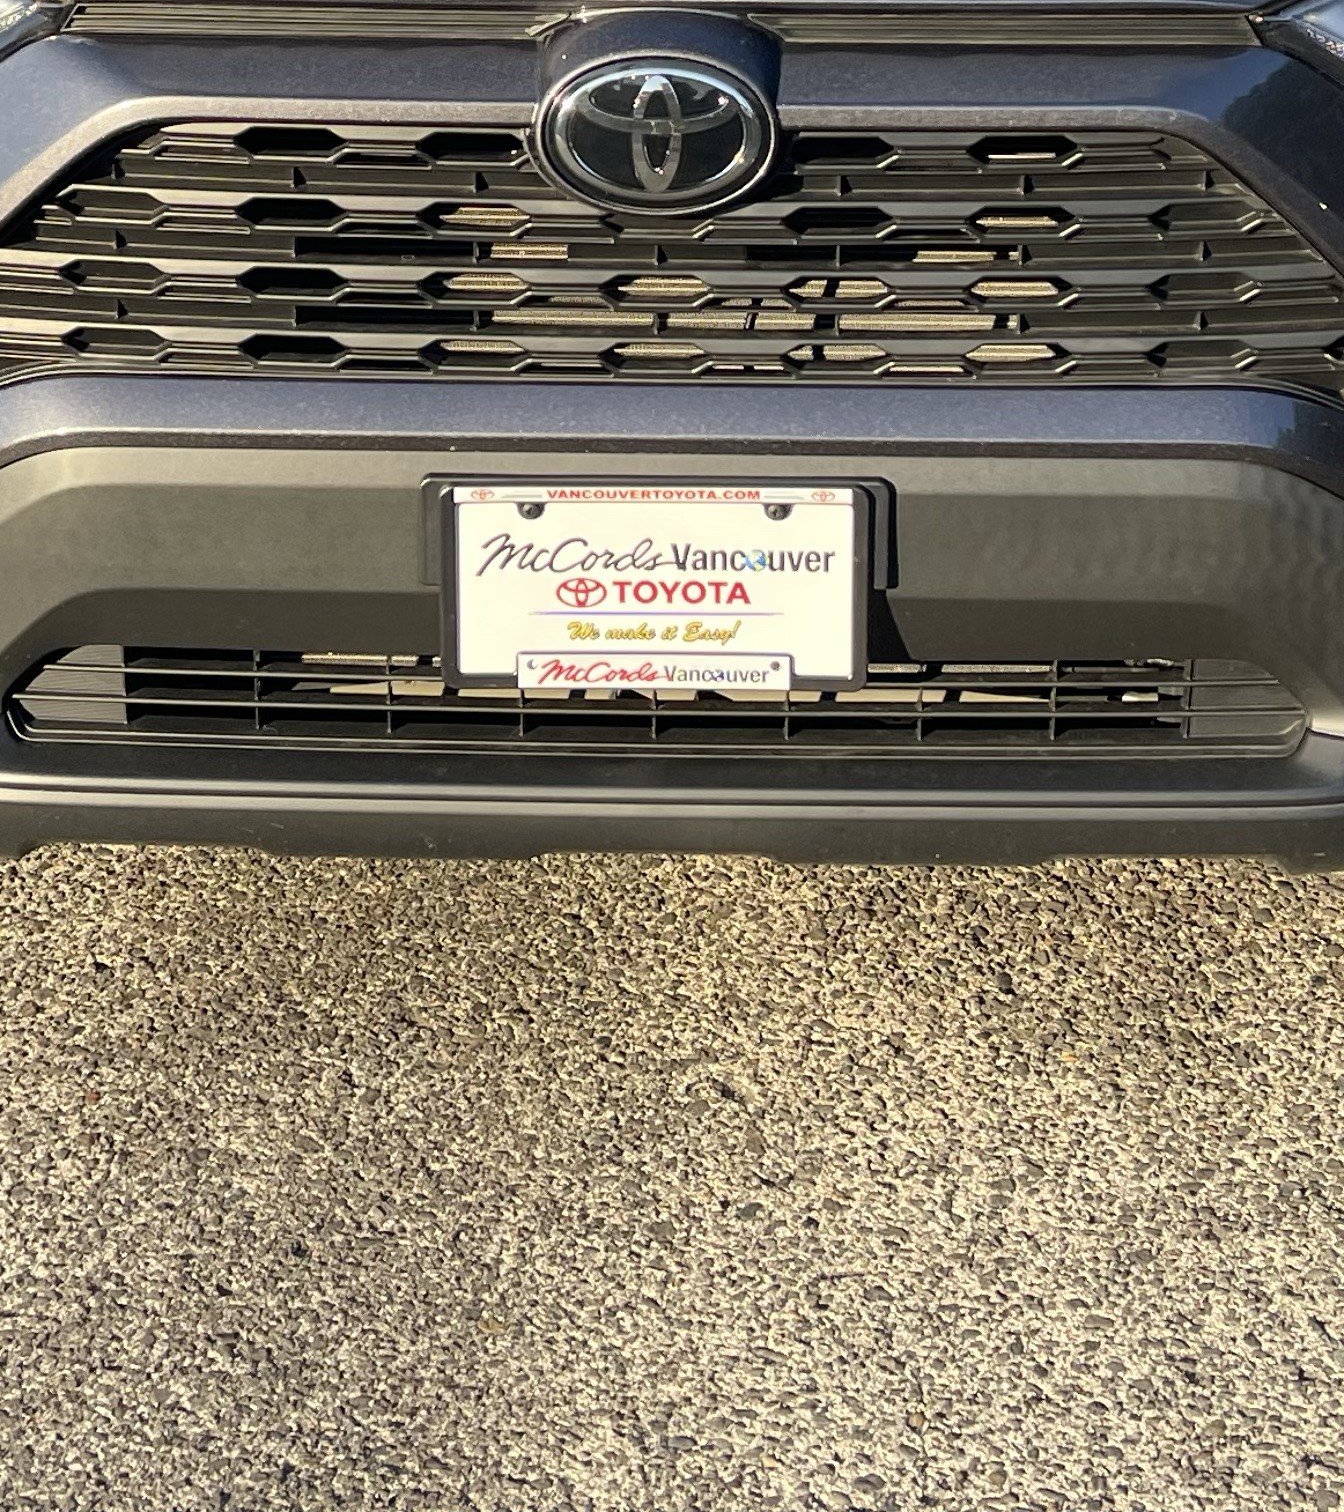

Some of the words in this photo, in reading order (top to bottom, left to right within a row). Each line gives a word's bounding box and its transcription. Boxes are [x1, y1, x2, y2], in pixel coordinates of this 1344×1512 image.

[546, 489, 760, 500] VANCOUVERTOYOTA.COM
[476, 533, 668, 576] McCords
[612, 580, 751, 605] TOYOTA
[567, 621, 600, 641] We
[605, 622, 656, 641] make
[661, 625, 678, 641] it
[682, 619, 742, 646] Easy!
[537, 659, 661, 684] McCords
